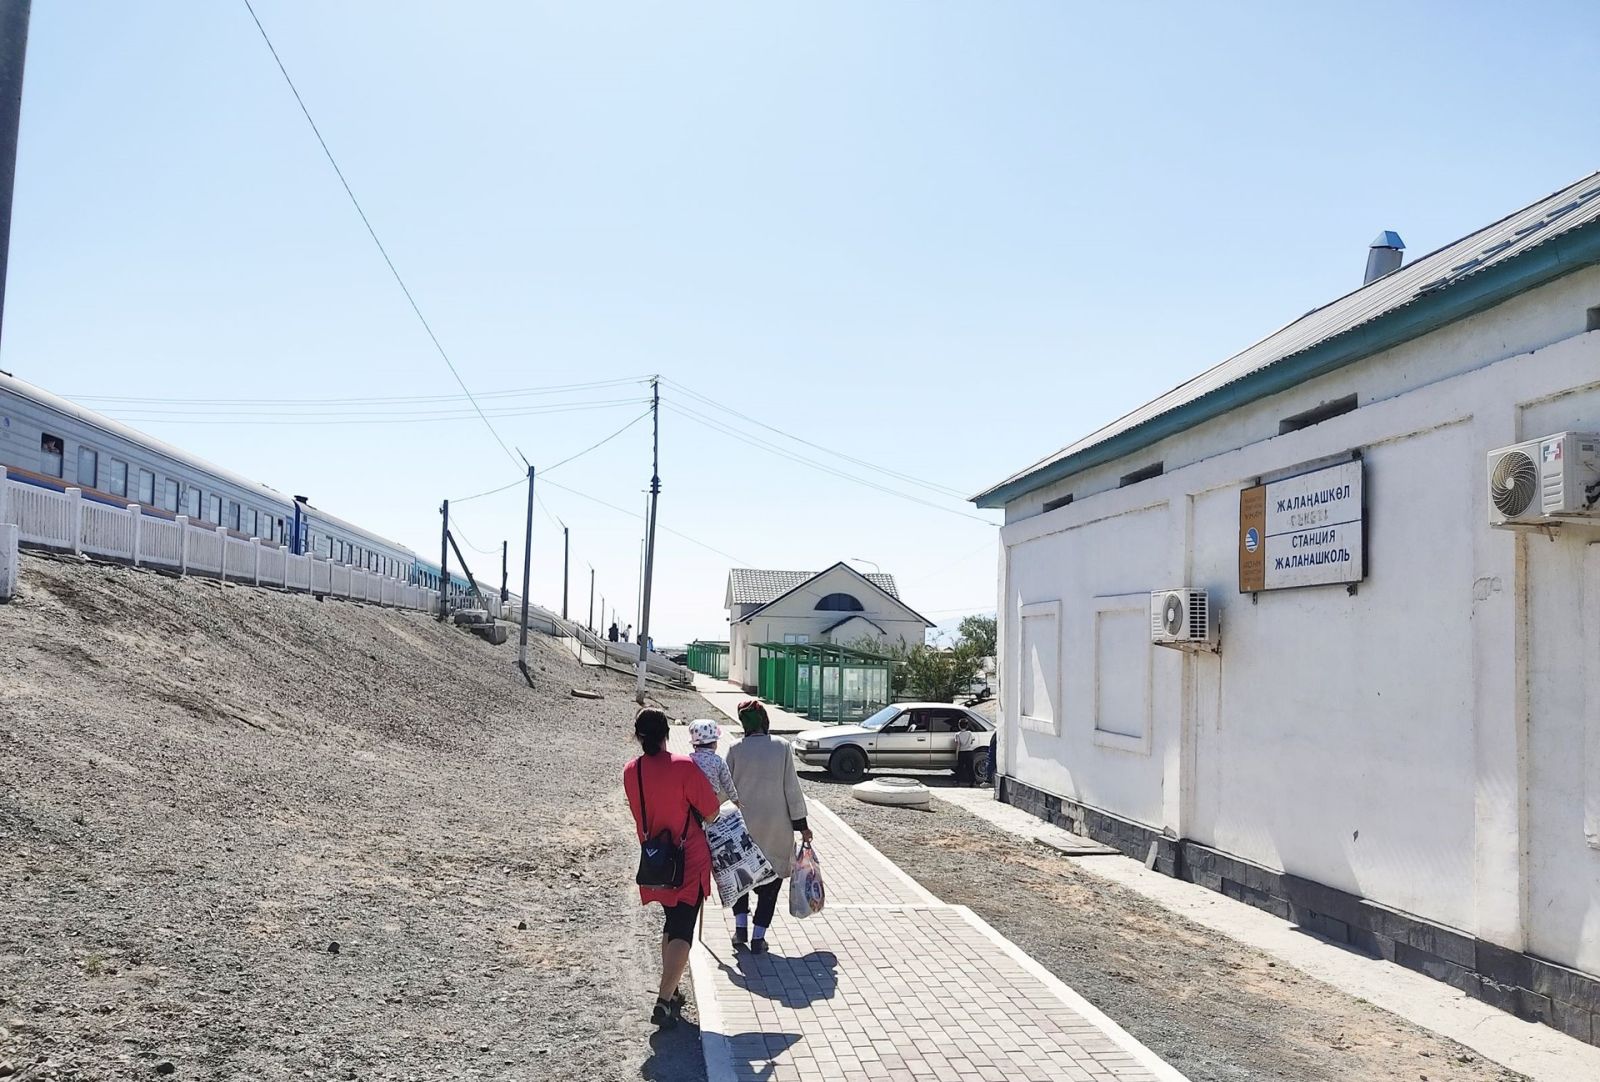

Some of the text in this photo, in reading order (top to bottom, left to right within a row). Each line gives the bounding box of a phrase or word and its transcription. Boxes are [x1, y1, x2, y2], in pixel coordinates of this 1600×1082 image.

[1277, 485, 1350, 513] ЖАЛАҢАШКӨЛ
[1292, 530, 1336, 547] СТАНЦИЯ
[1275, 548, 1350, 570] ЖАЛАНАШКОЛЬ
